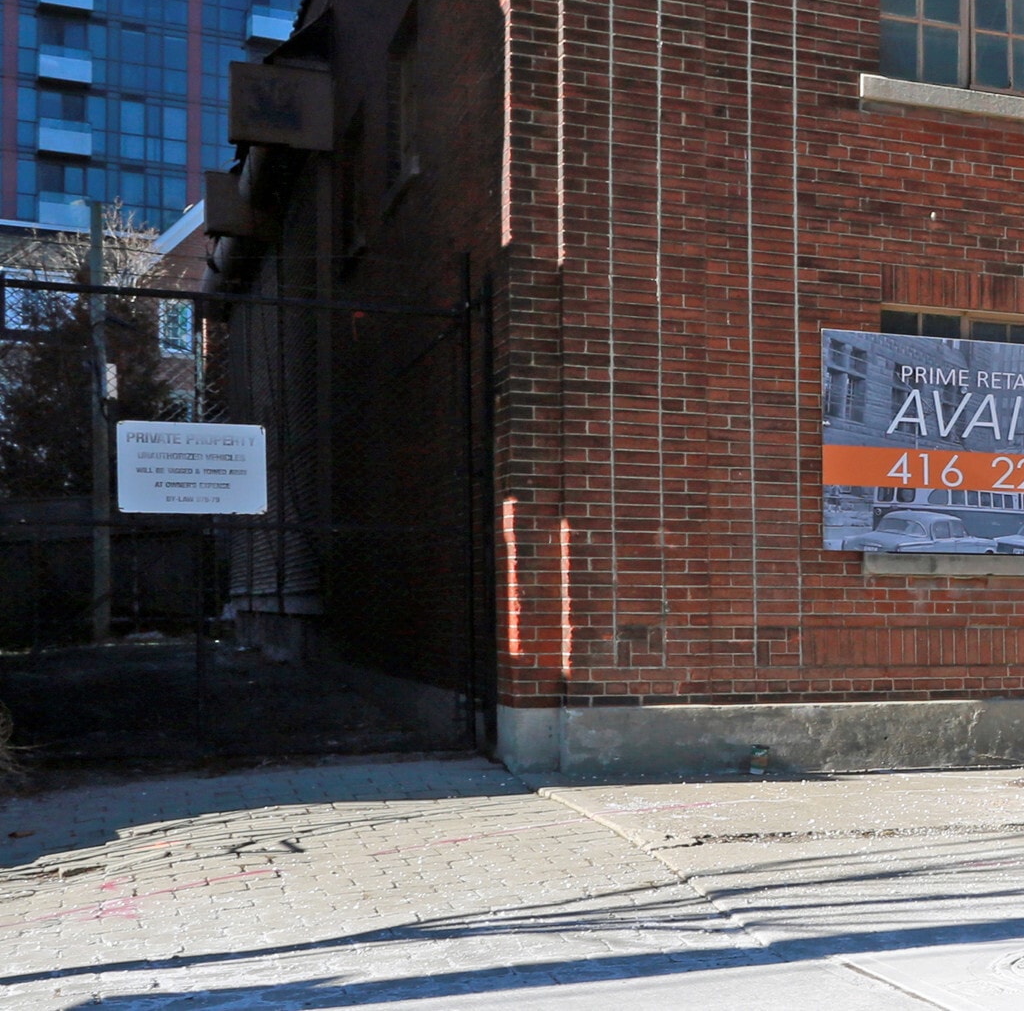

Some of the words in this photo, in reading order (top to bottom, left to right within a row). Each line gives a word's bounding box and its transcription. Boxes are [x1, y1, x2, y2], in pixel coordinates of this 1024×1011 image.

[900, 364, 970, 388] PRIME
[126, 431, 181, 444] PRIVATE
[186, 433, 256, 447] PROPERTY
[205, 453, 246, 462] VEHICLES
[887, 452, 964, 488] 416
